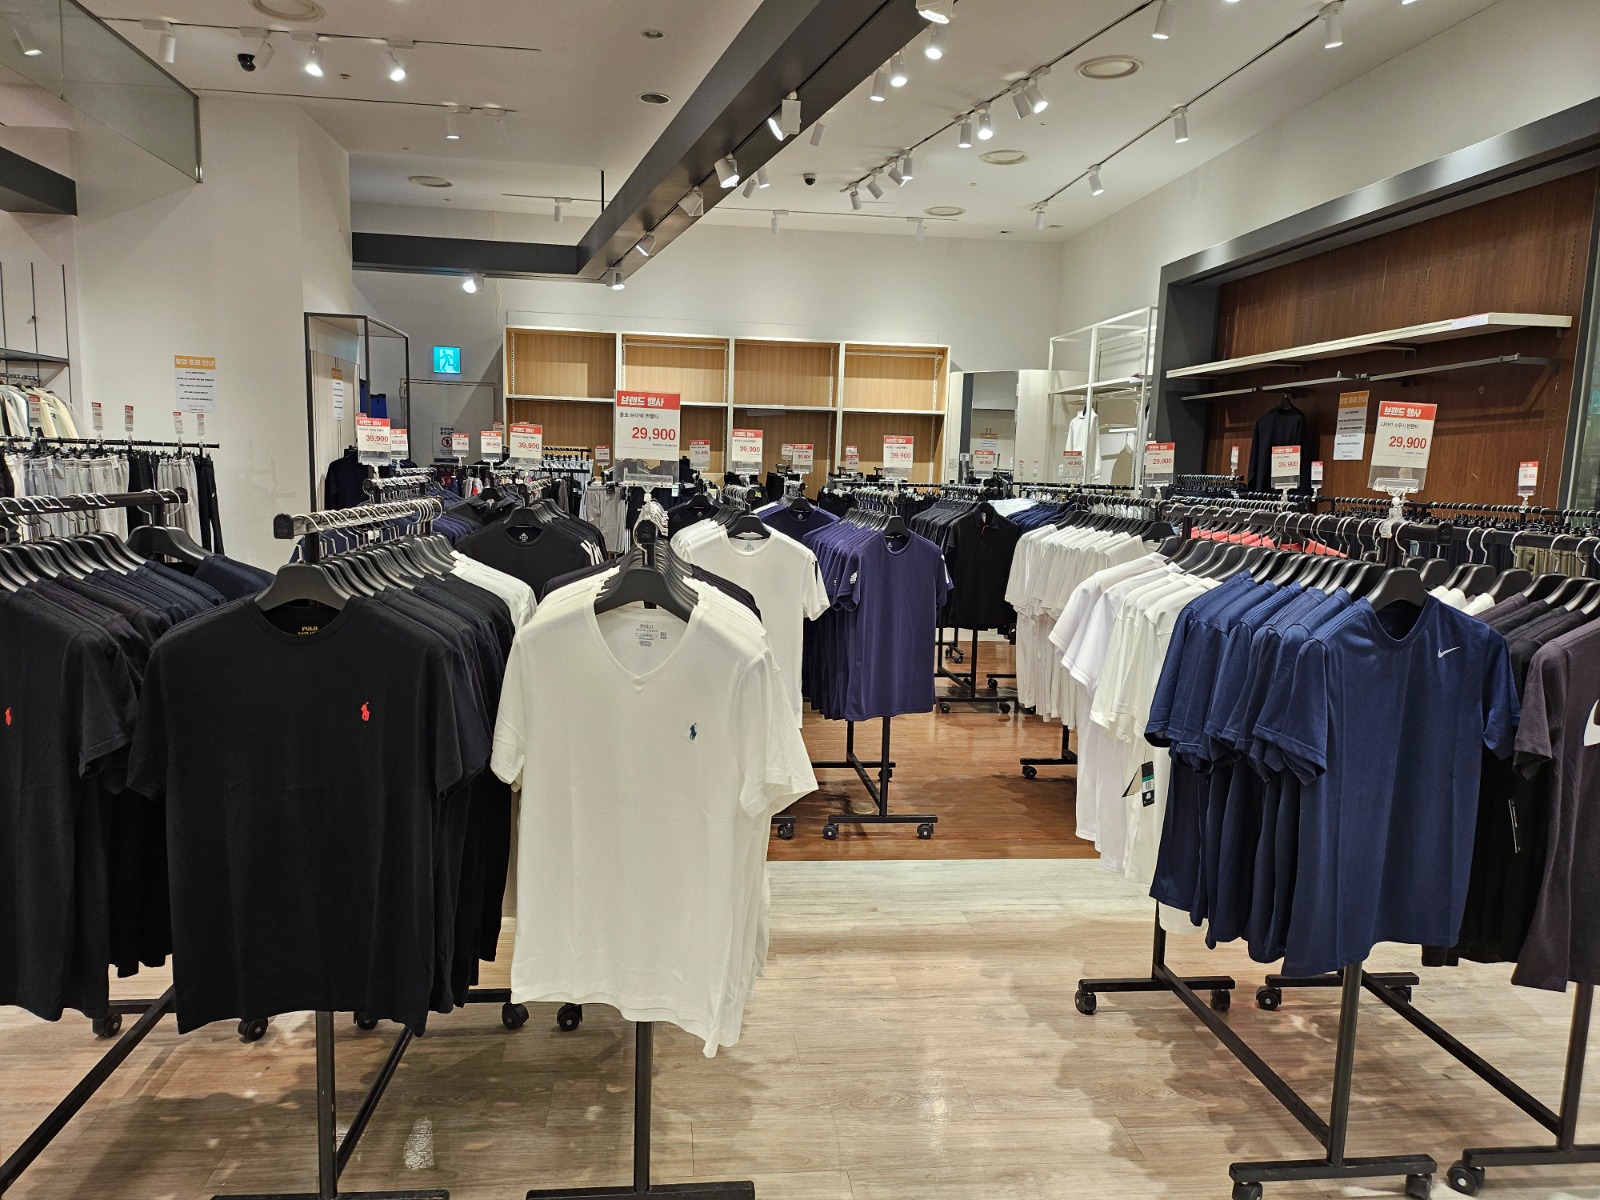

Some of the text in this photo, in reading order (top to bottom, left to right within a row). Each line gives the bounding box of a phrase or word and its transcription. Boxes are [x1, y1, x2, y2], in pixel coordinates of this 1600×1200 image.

[620, 395, 665, 407] 브랜드 행사
[1383, 406, 1422, 418] 브랜드 행사
[365, 434, 389, 442] 39,900
[631, 426, 676, 441] 29,900
[517, 441, 540, 450] 39,900
[1388, 435, 1427, 449] 29,900
[739, 445, 761, 453] 39,900
[1152, 457, 1173, 465] 29,900
[1278, 460, 1299, 468] 29,900
